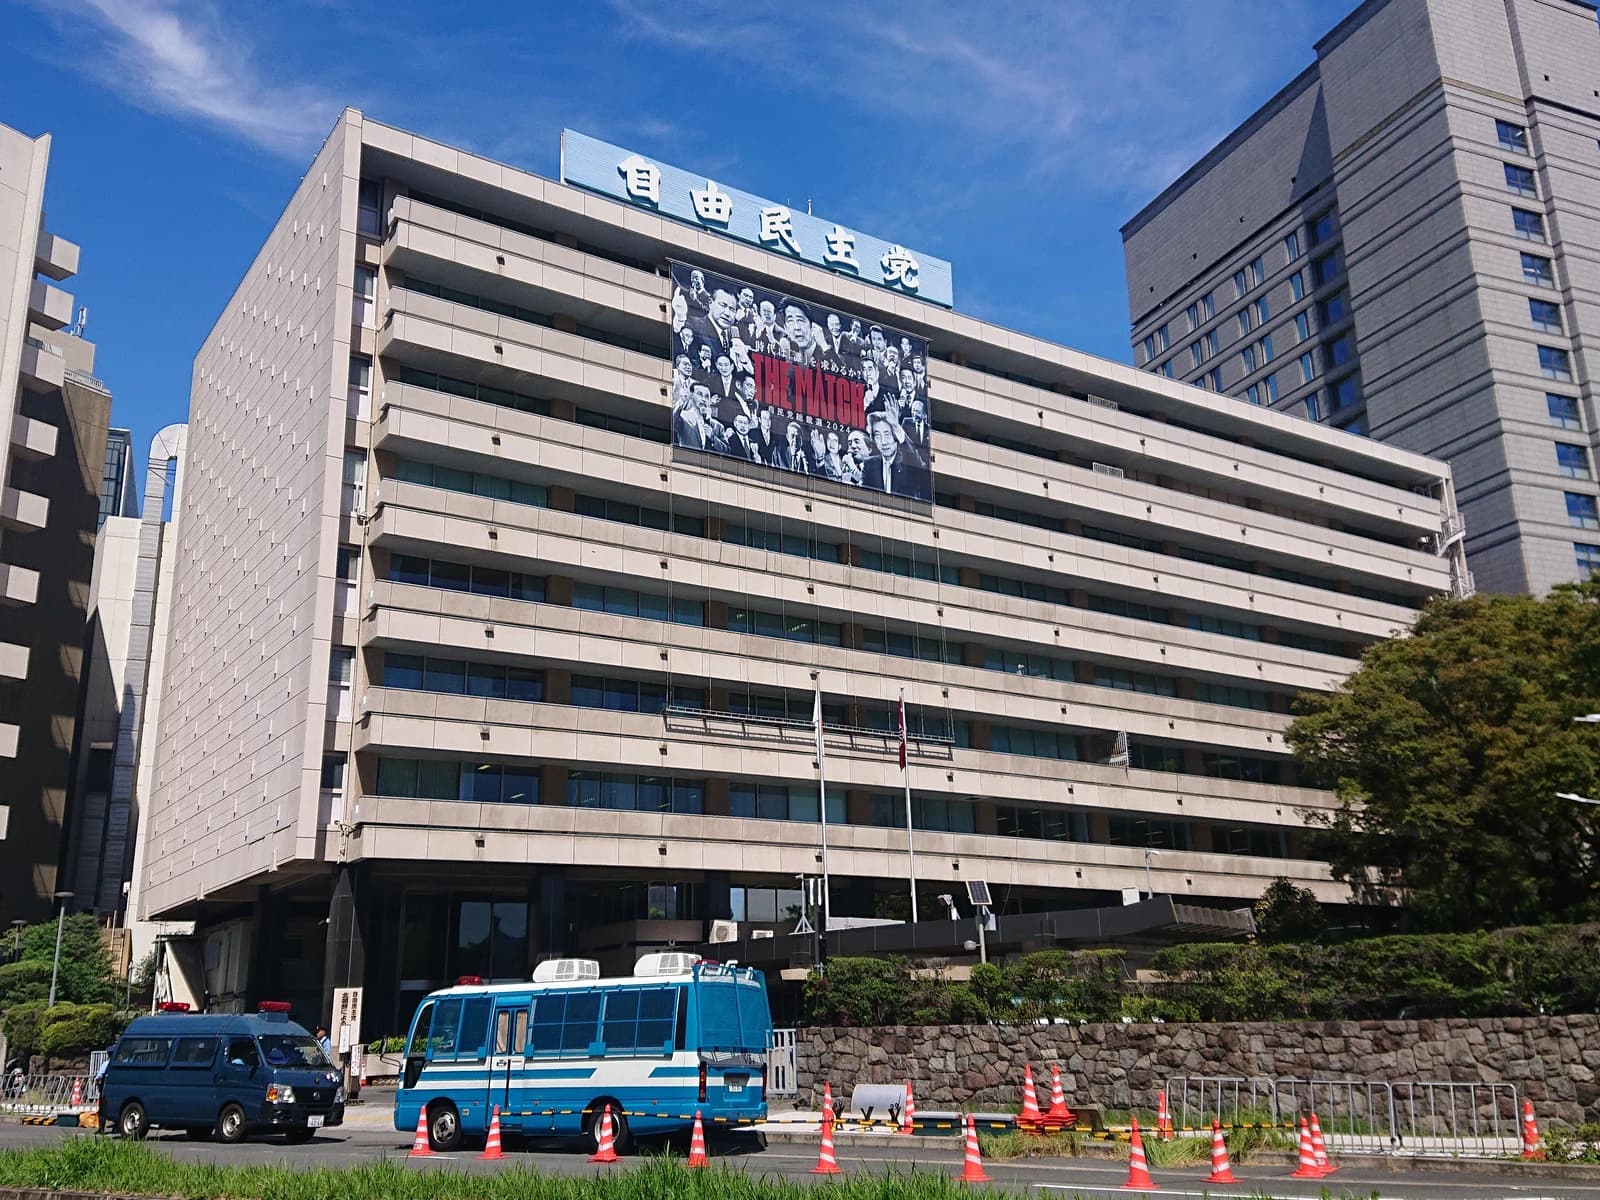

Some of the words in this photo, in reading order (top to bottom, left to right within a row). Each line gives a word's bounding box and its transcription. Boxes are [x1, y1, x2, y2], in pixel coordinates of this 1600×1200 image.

[617, 153, 920, 296] 自由民主党
[752, 352, 792, 411] THE
[794, 359, 866, 430] MATCH
